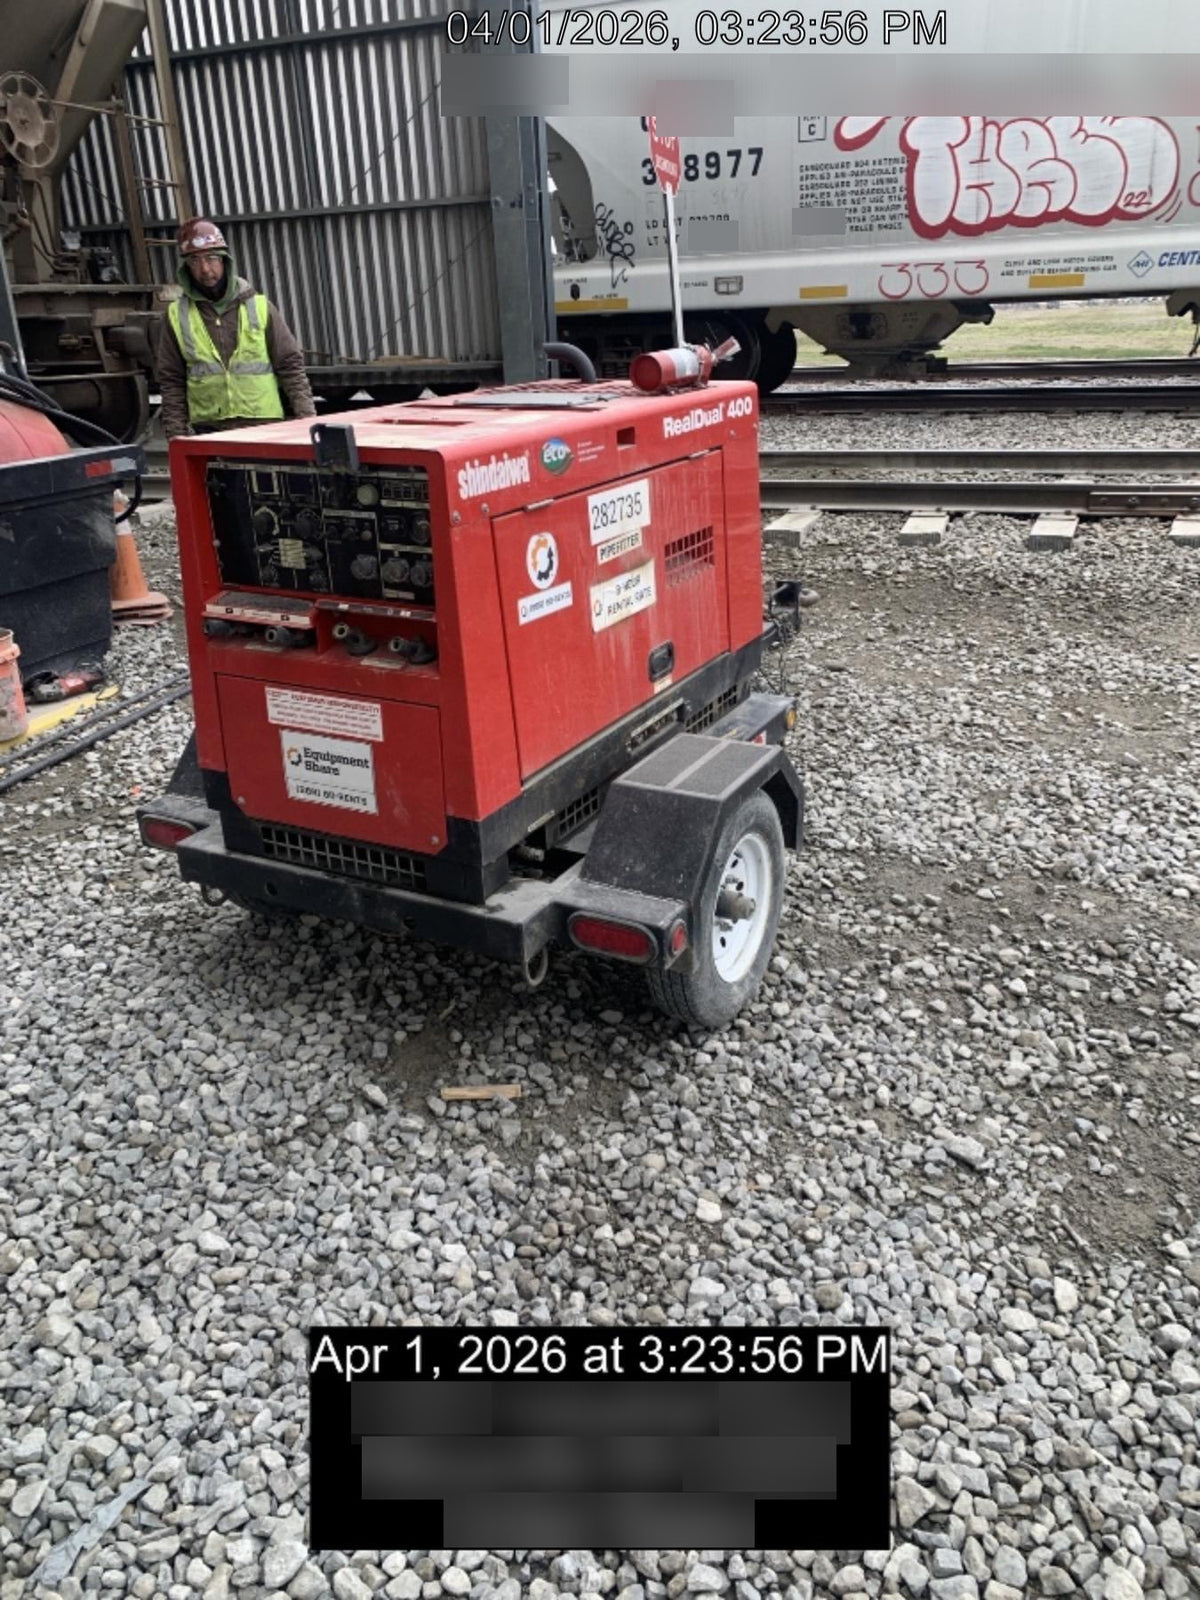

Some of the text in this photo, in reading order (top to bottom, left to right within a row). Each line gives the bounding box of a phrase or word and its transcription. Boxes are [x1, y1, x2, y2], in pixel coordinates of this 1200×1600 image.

[808, 124, 816, 136] C
[641, 147, 763, 186] 38977
[663, 396, 753, 439] RealDual 400
[457, 451, 531, 500] shindaiwa
[592, 492, 643, 530] 282735
[303, 747, 370, 769] Equipment
[304, 761, 340, 776] Share
